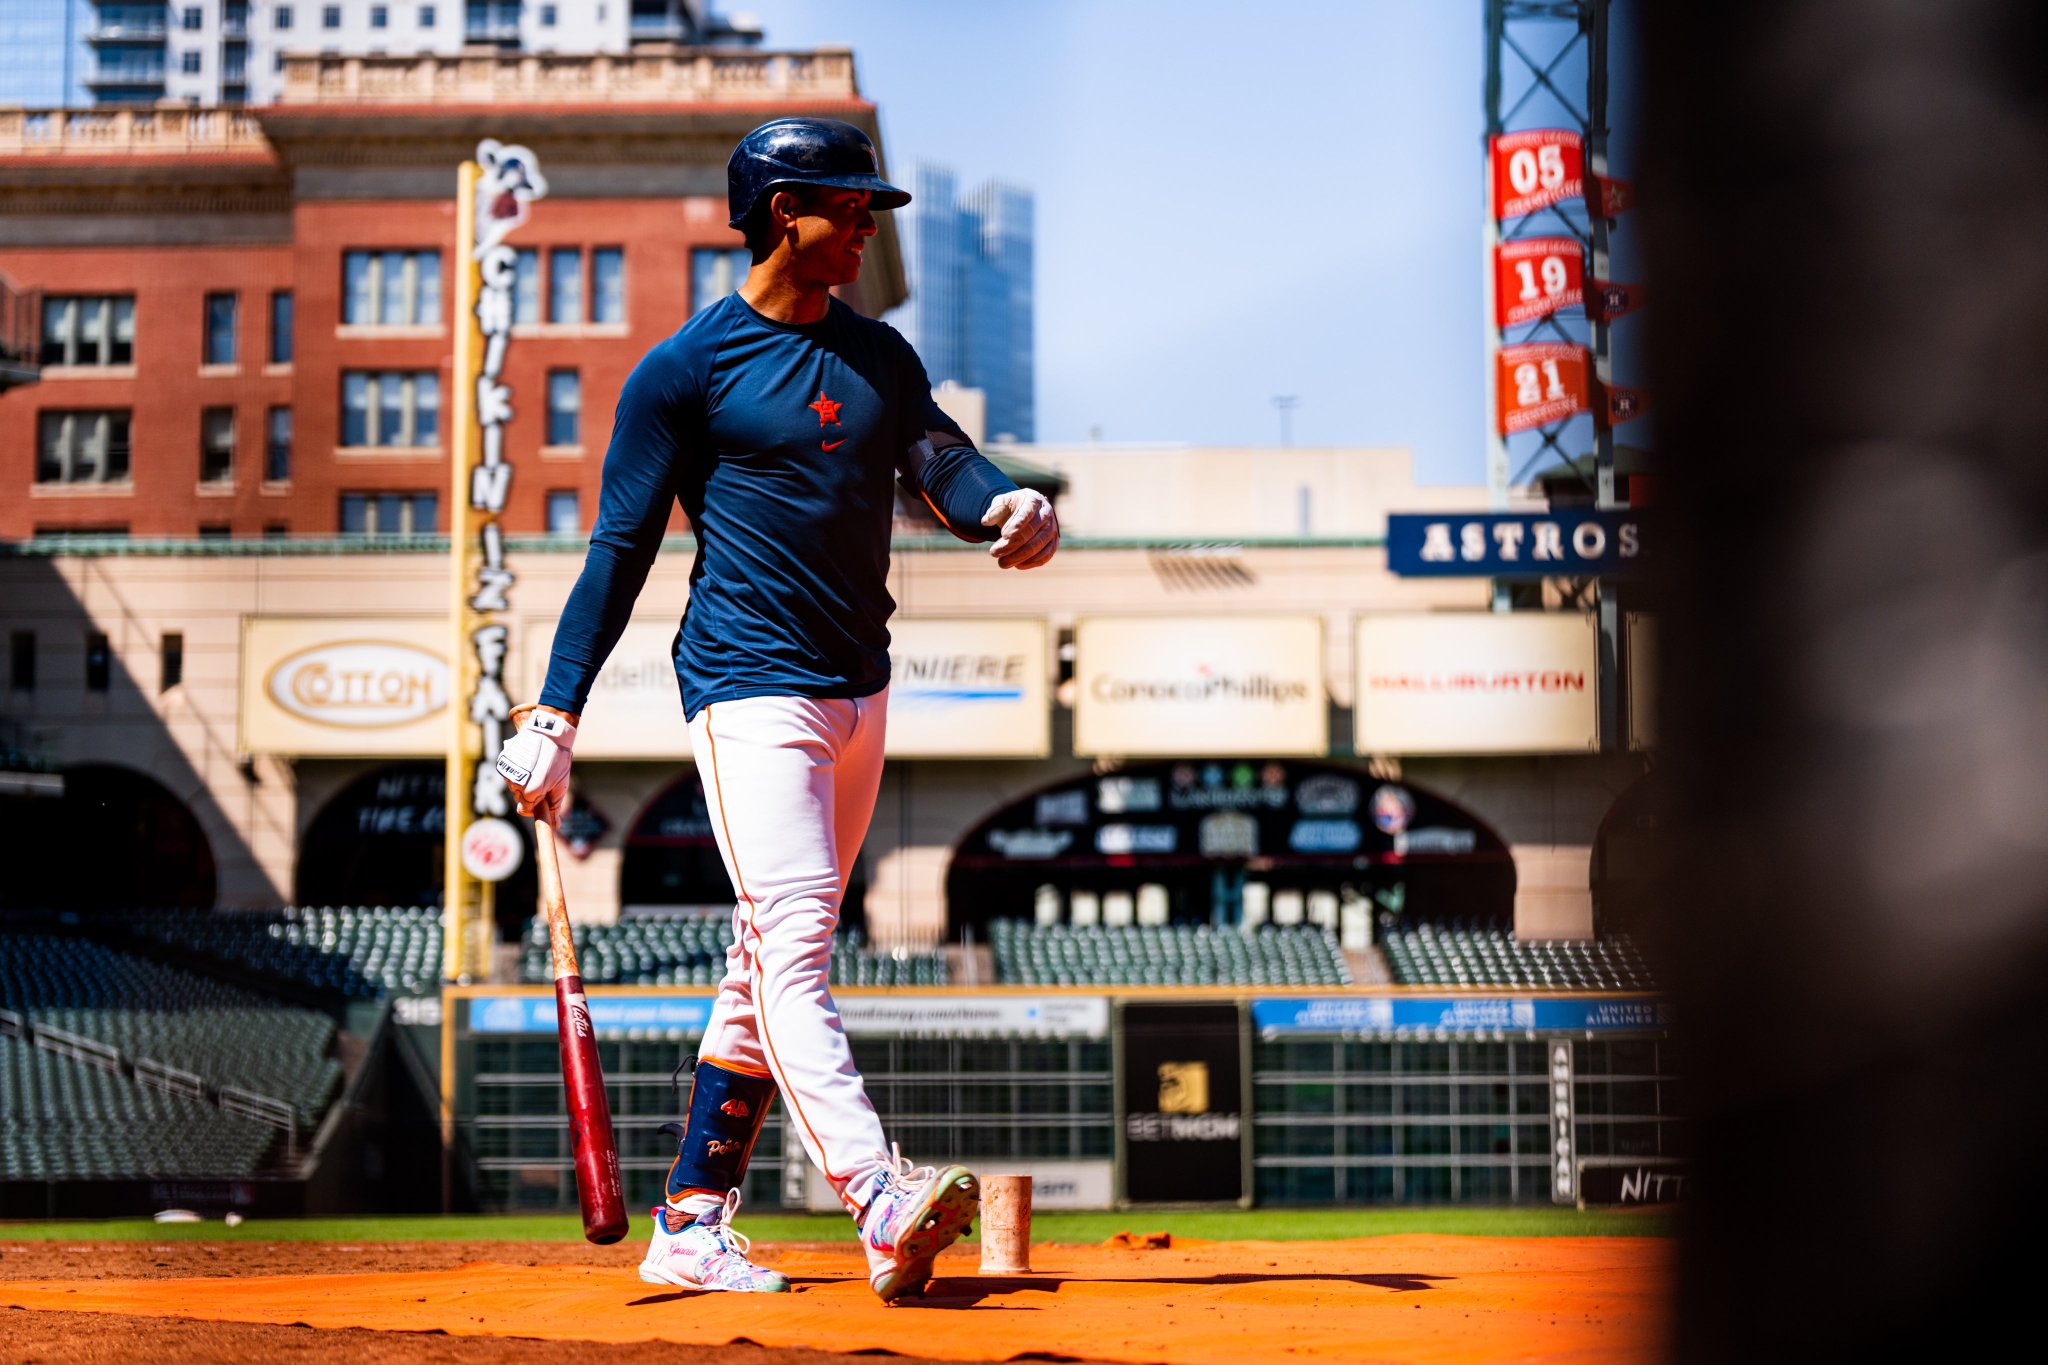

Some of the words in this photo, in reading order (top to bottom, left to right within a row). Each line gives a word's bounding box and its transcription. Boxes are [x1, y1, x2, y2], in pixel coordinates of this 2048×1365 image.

[1509, 143, 1565, 195] 05
[1514, 255, 1567, 301] 19
[471, 244, 518, 511] CHIKIN
[1514, 358, 1566, 407] 21
[1419, 521, 1640, 563] ASTROS
[291, 661, 433, 708] COTTON
[1090, 671, 1308, 707] ConocoPhillips
[1369, 671, 1585, 693] HALLIBURTON
[498, 759, 528, 782] Franklin
[565, 993, 590, 1038] Victus
[1586, 1014, 1652, 1025] AIRLINES
[1599, 1005, 1652, 1014] UNITED
[1127, 1112, 1240, 1141] BETMGM
[1620, 1166, 1688, 1202] NITT
[668, 1241, 698, 1257] Gracias
